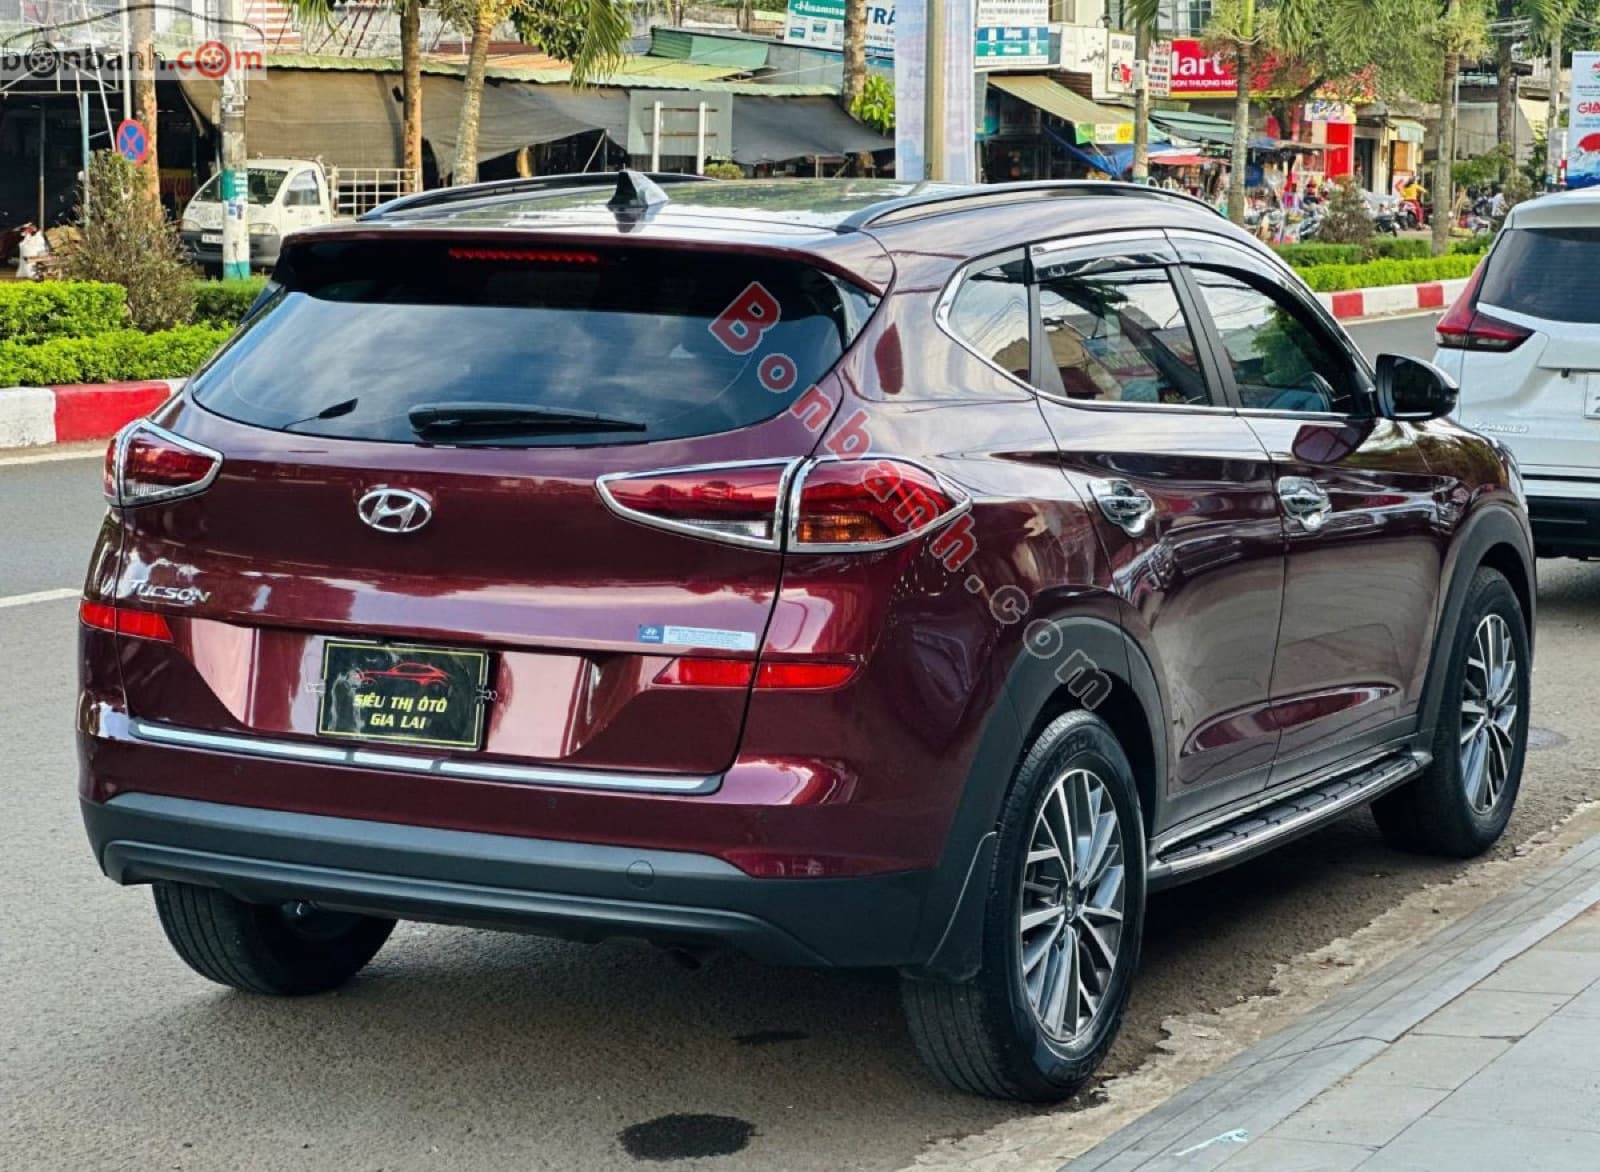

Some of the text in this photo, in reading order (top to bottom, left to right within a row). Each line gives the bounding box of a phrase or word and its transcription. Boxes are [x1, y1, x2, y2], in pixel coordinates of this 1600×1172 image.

[391, 696, 414, 713] THỊ
[417, 696, 448, 713] ÔTÔ
[370, 713, 427, 730] GIA LAI
